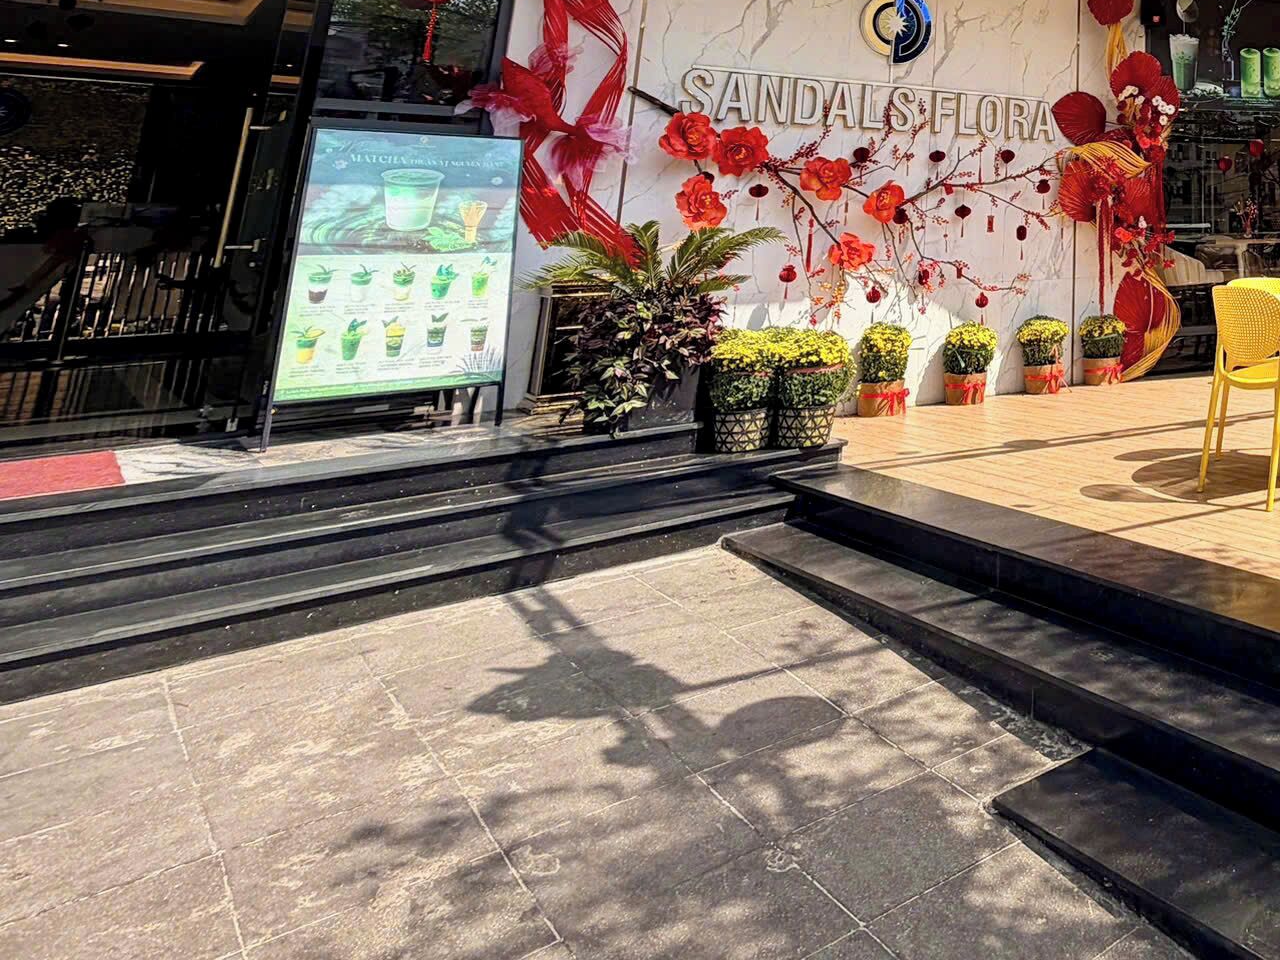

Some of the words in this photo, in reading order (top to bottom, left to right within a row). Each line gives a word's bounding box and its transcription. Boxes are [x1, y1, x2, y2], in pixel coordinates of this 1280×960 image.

[680, 68, 917, 133] SANDALS
[929, 89, 1057, 141] FLORA
[351, 153, 407, 165] MATCHA
